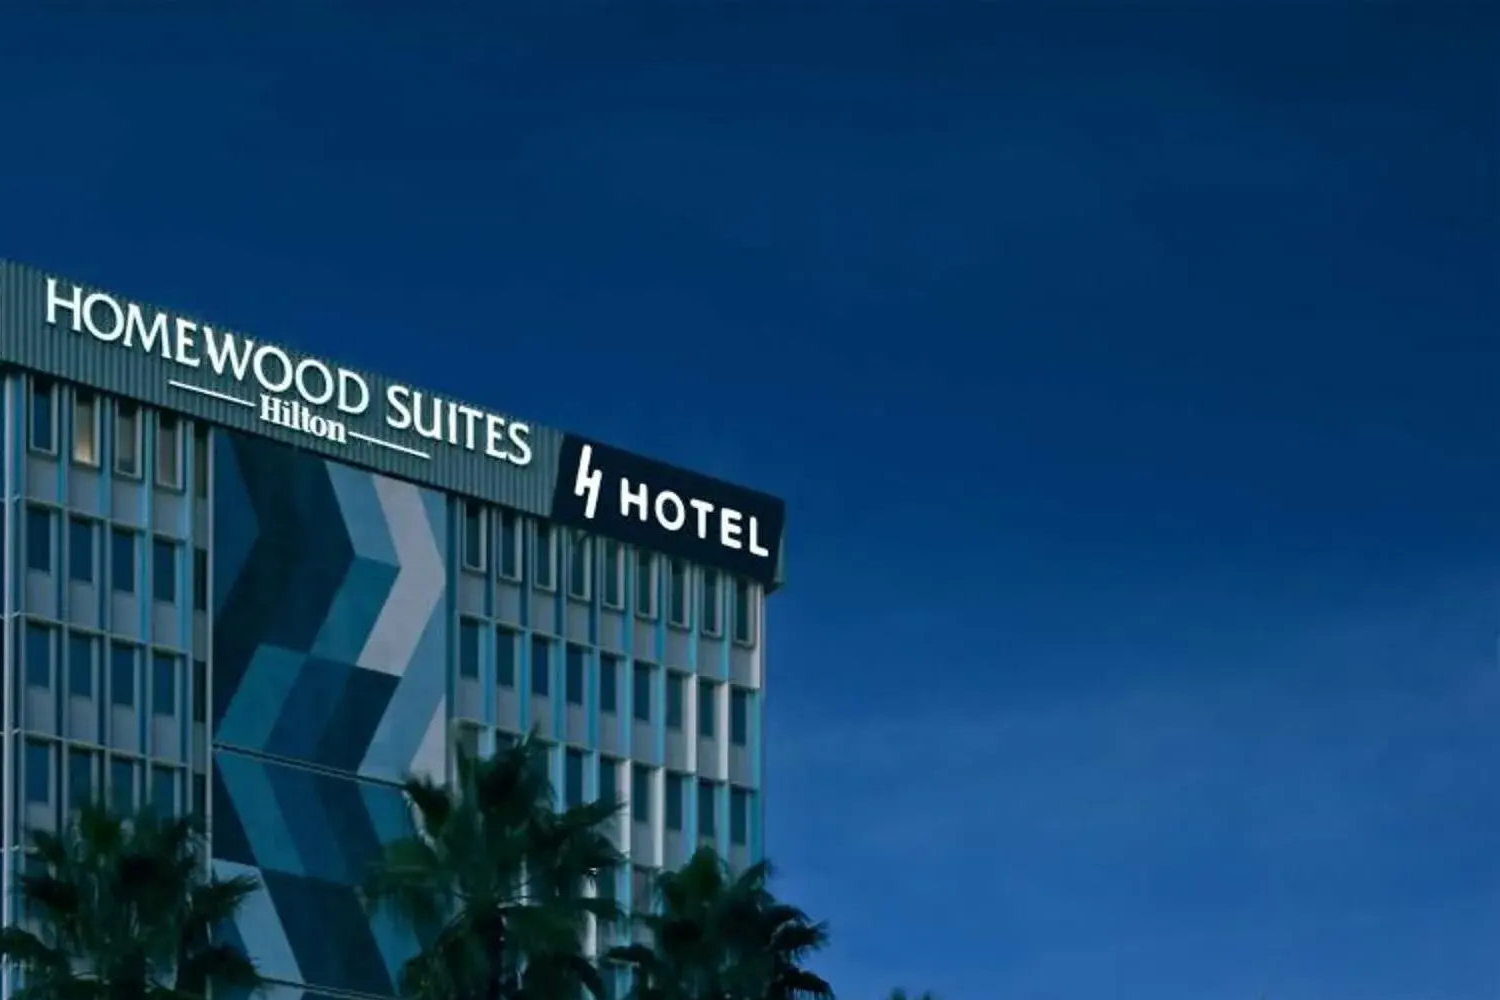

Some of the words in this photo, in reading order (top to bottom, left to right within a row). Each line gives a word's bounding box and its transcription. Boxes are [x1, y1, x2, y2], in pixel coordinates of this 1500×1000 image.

[45, 276, 371, 416] HOMEWOOD
[386, 384, 534, 467] SUITES
[259, 394, 347, 444] Hilton
[619, 476, 770, 558] HOTEL
